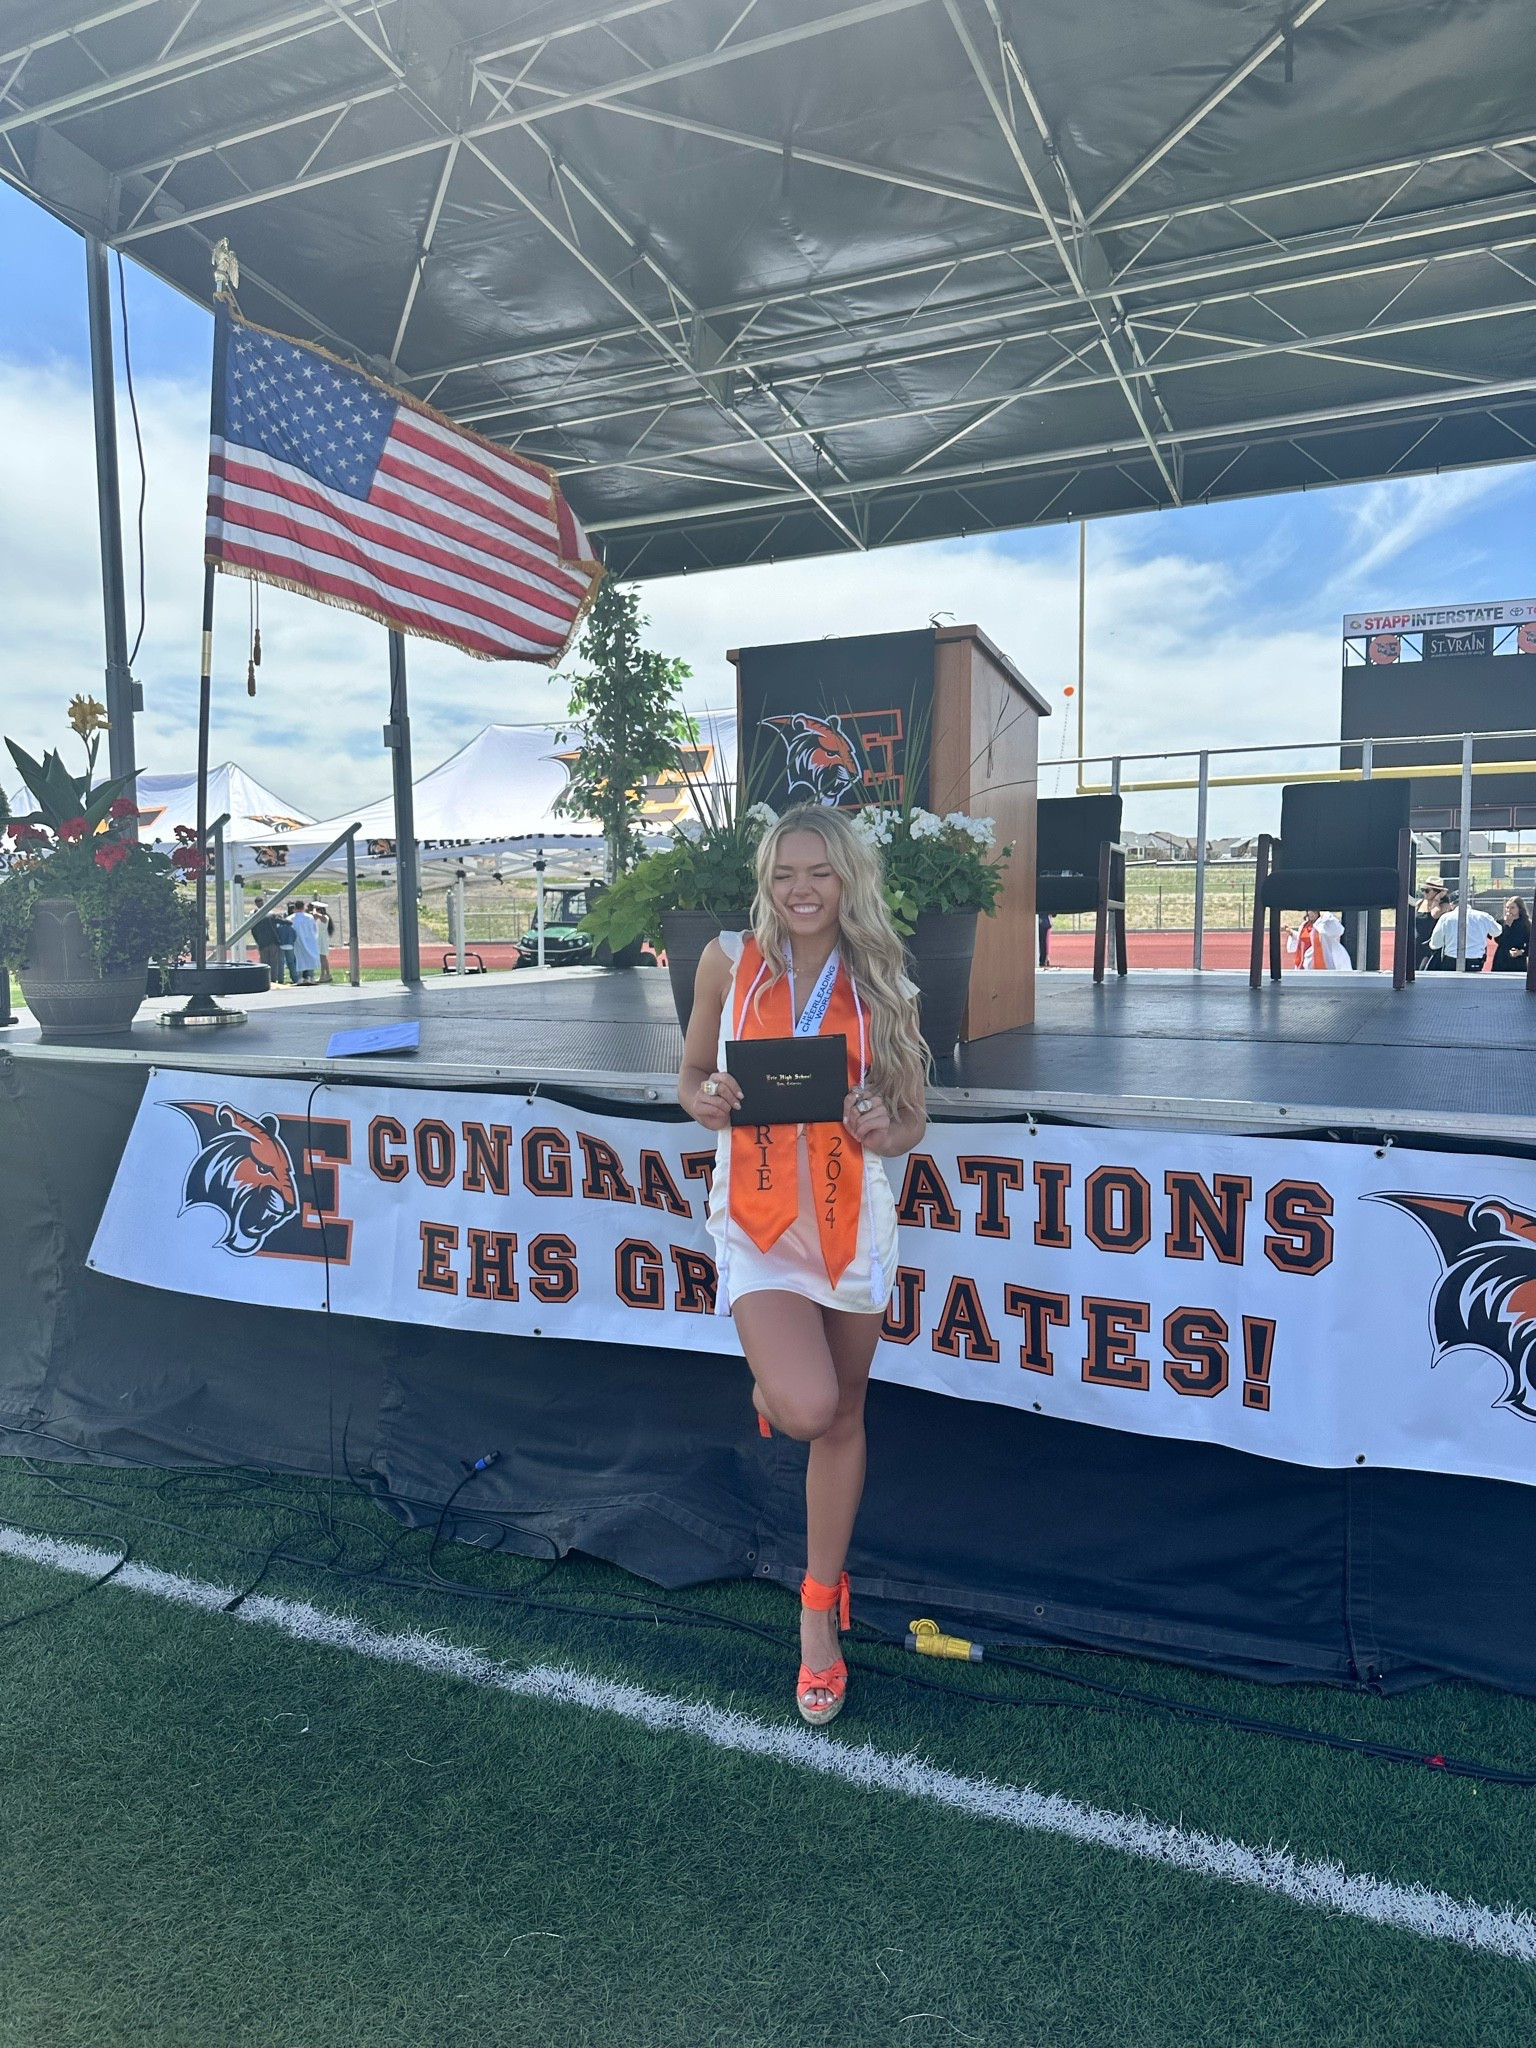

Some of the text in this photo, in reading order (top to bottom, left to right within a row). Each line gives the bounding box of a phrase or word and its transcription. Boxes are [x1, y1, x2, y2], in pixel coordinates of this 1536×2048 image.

[801, 965, 836, 1033] CHEERLEADING
[754, 1124, 773, 1191] RIE
[825, 1136, 842, 1229] 2024
[417, 1220, 1277, 1412] EHS GRUATES!
